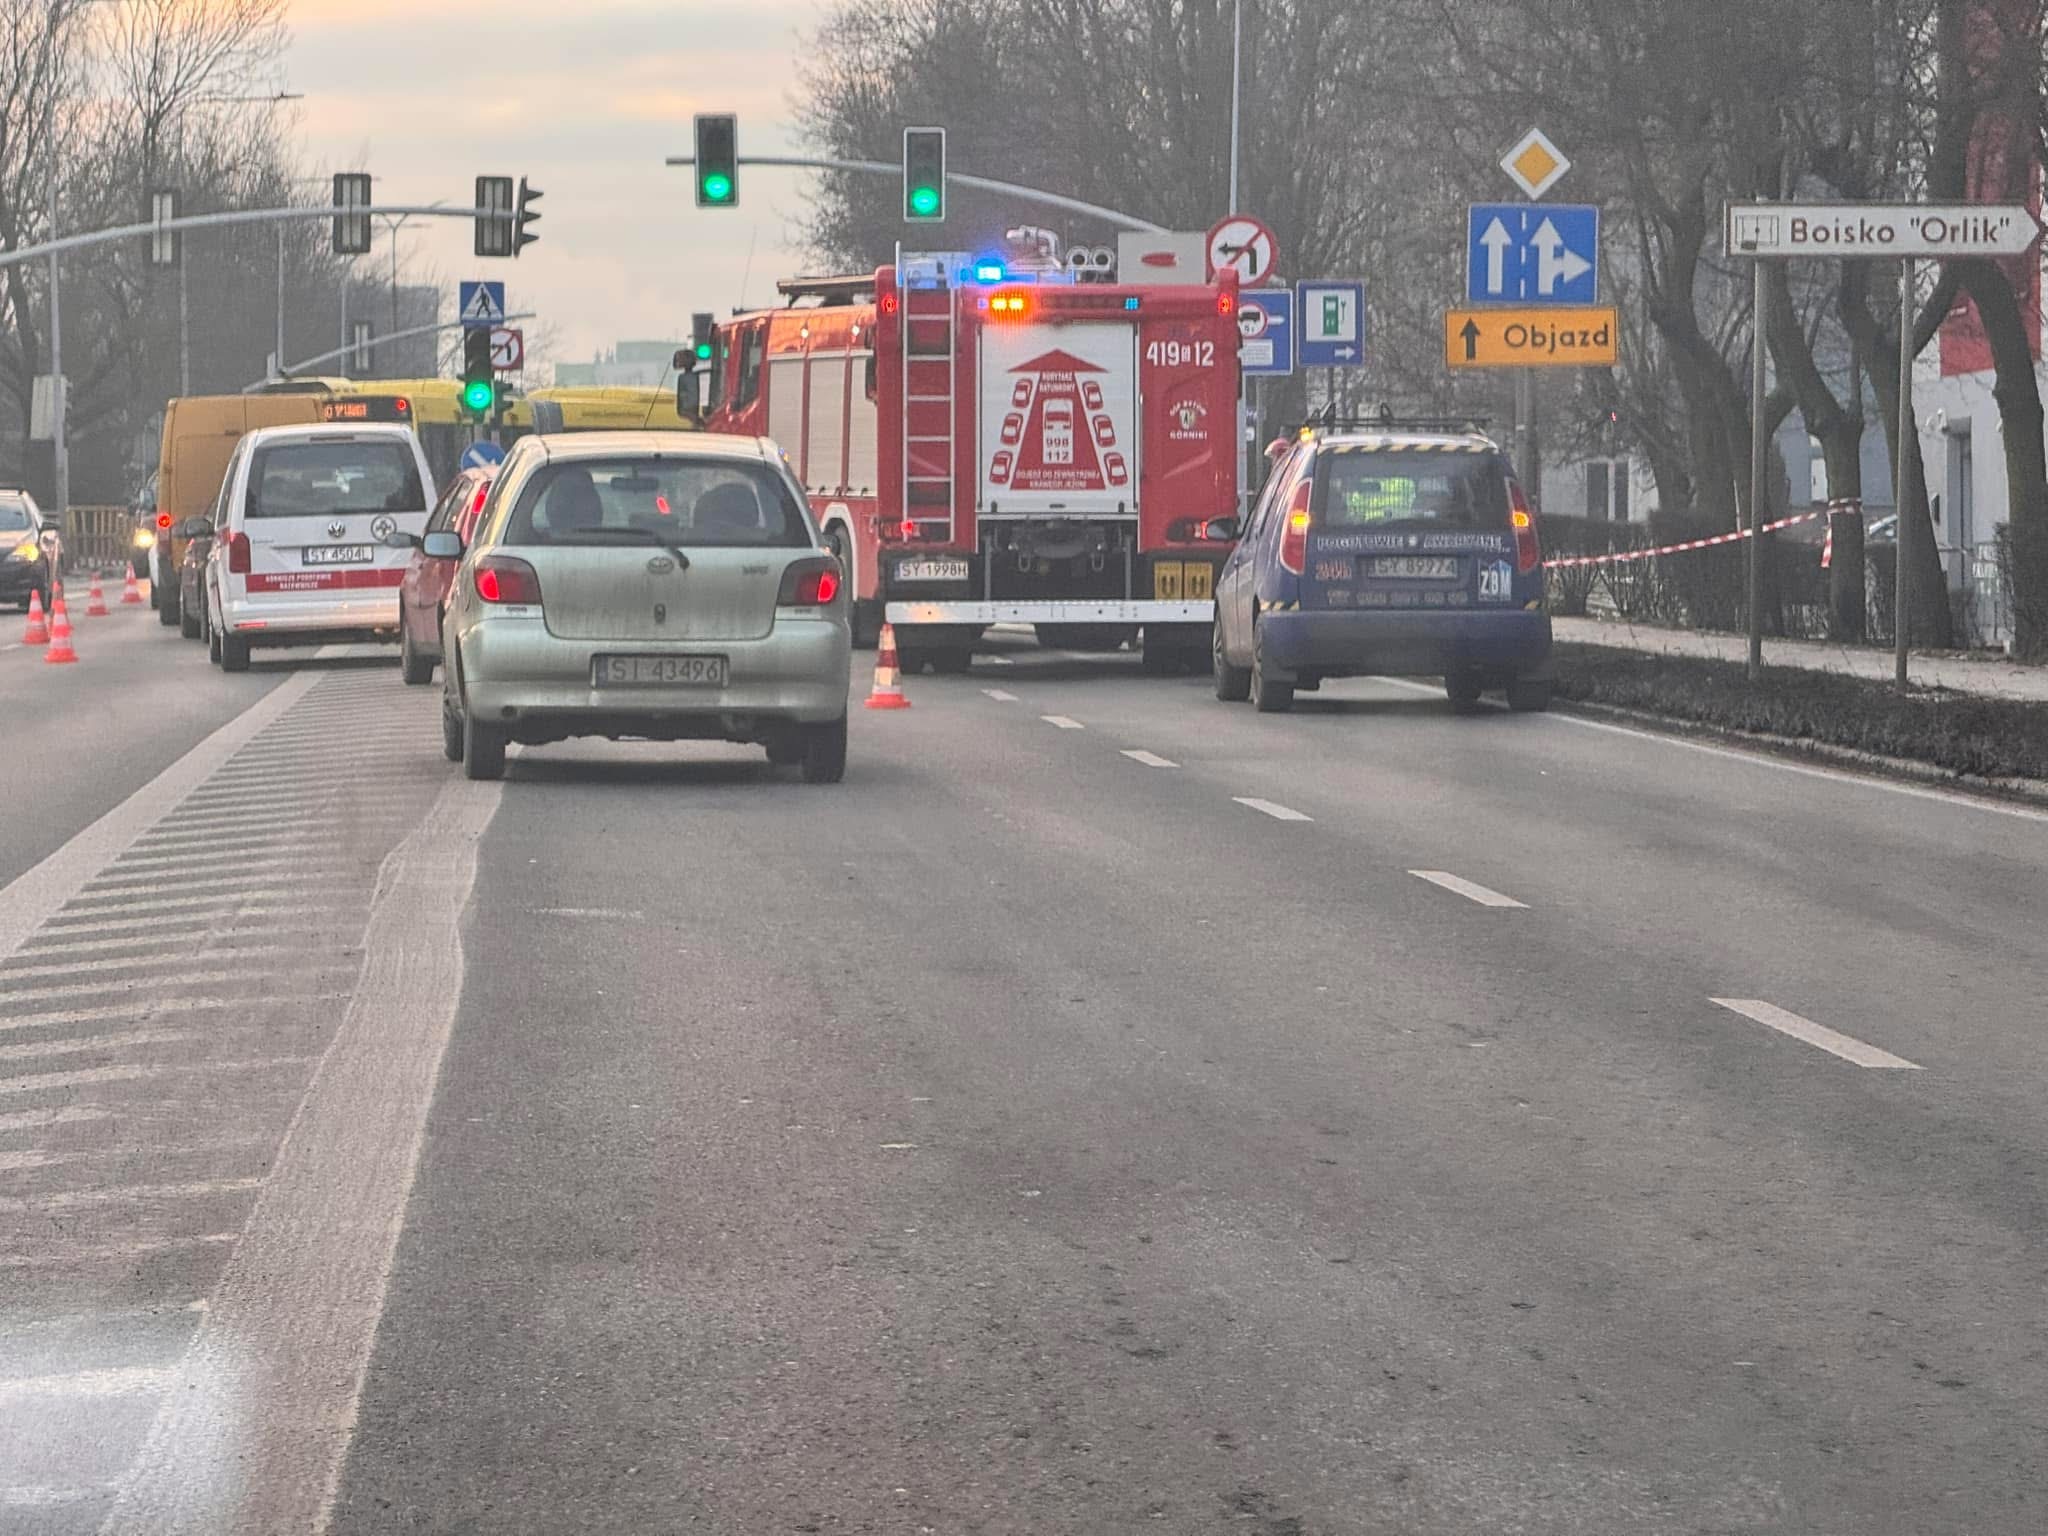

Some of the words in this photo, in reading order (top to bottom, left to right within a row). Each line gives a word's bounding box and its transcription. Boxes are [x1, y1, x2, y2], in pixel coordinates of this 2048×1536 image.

[1790, 217, 1895, 244] Boisko
[1910, 216, 2011, 244] "Orlik"
[1503, 323, 1609, 355] Objazd
[1146, 341, 1180, 367] 419
[1195, 341, 1214, 367] 12
[1047, 451, 1069, 461] 112
[902, 564, 920, 577] SY
[927, 564, 967, 577] 1998H
[611, 659, 639, 682] SI
[652, 659, 718, 682] 43496
